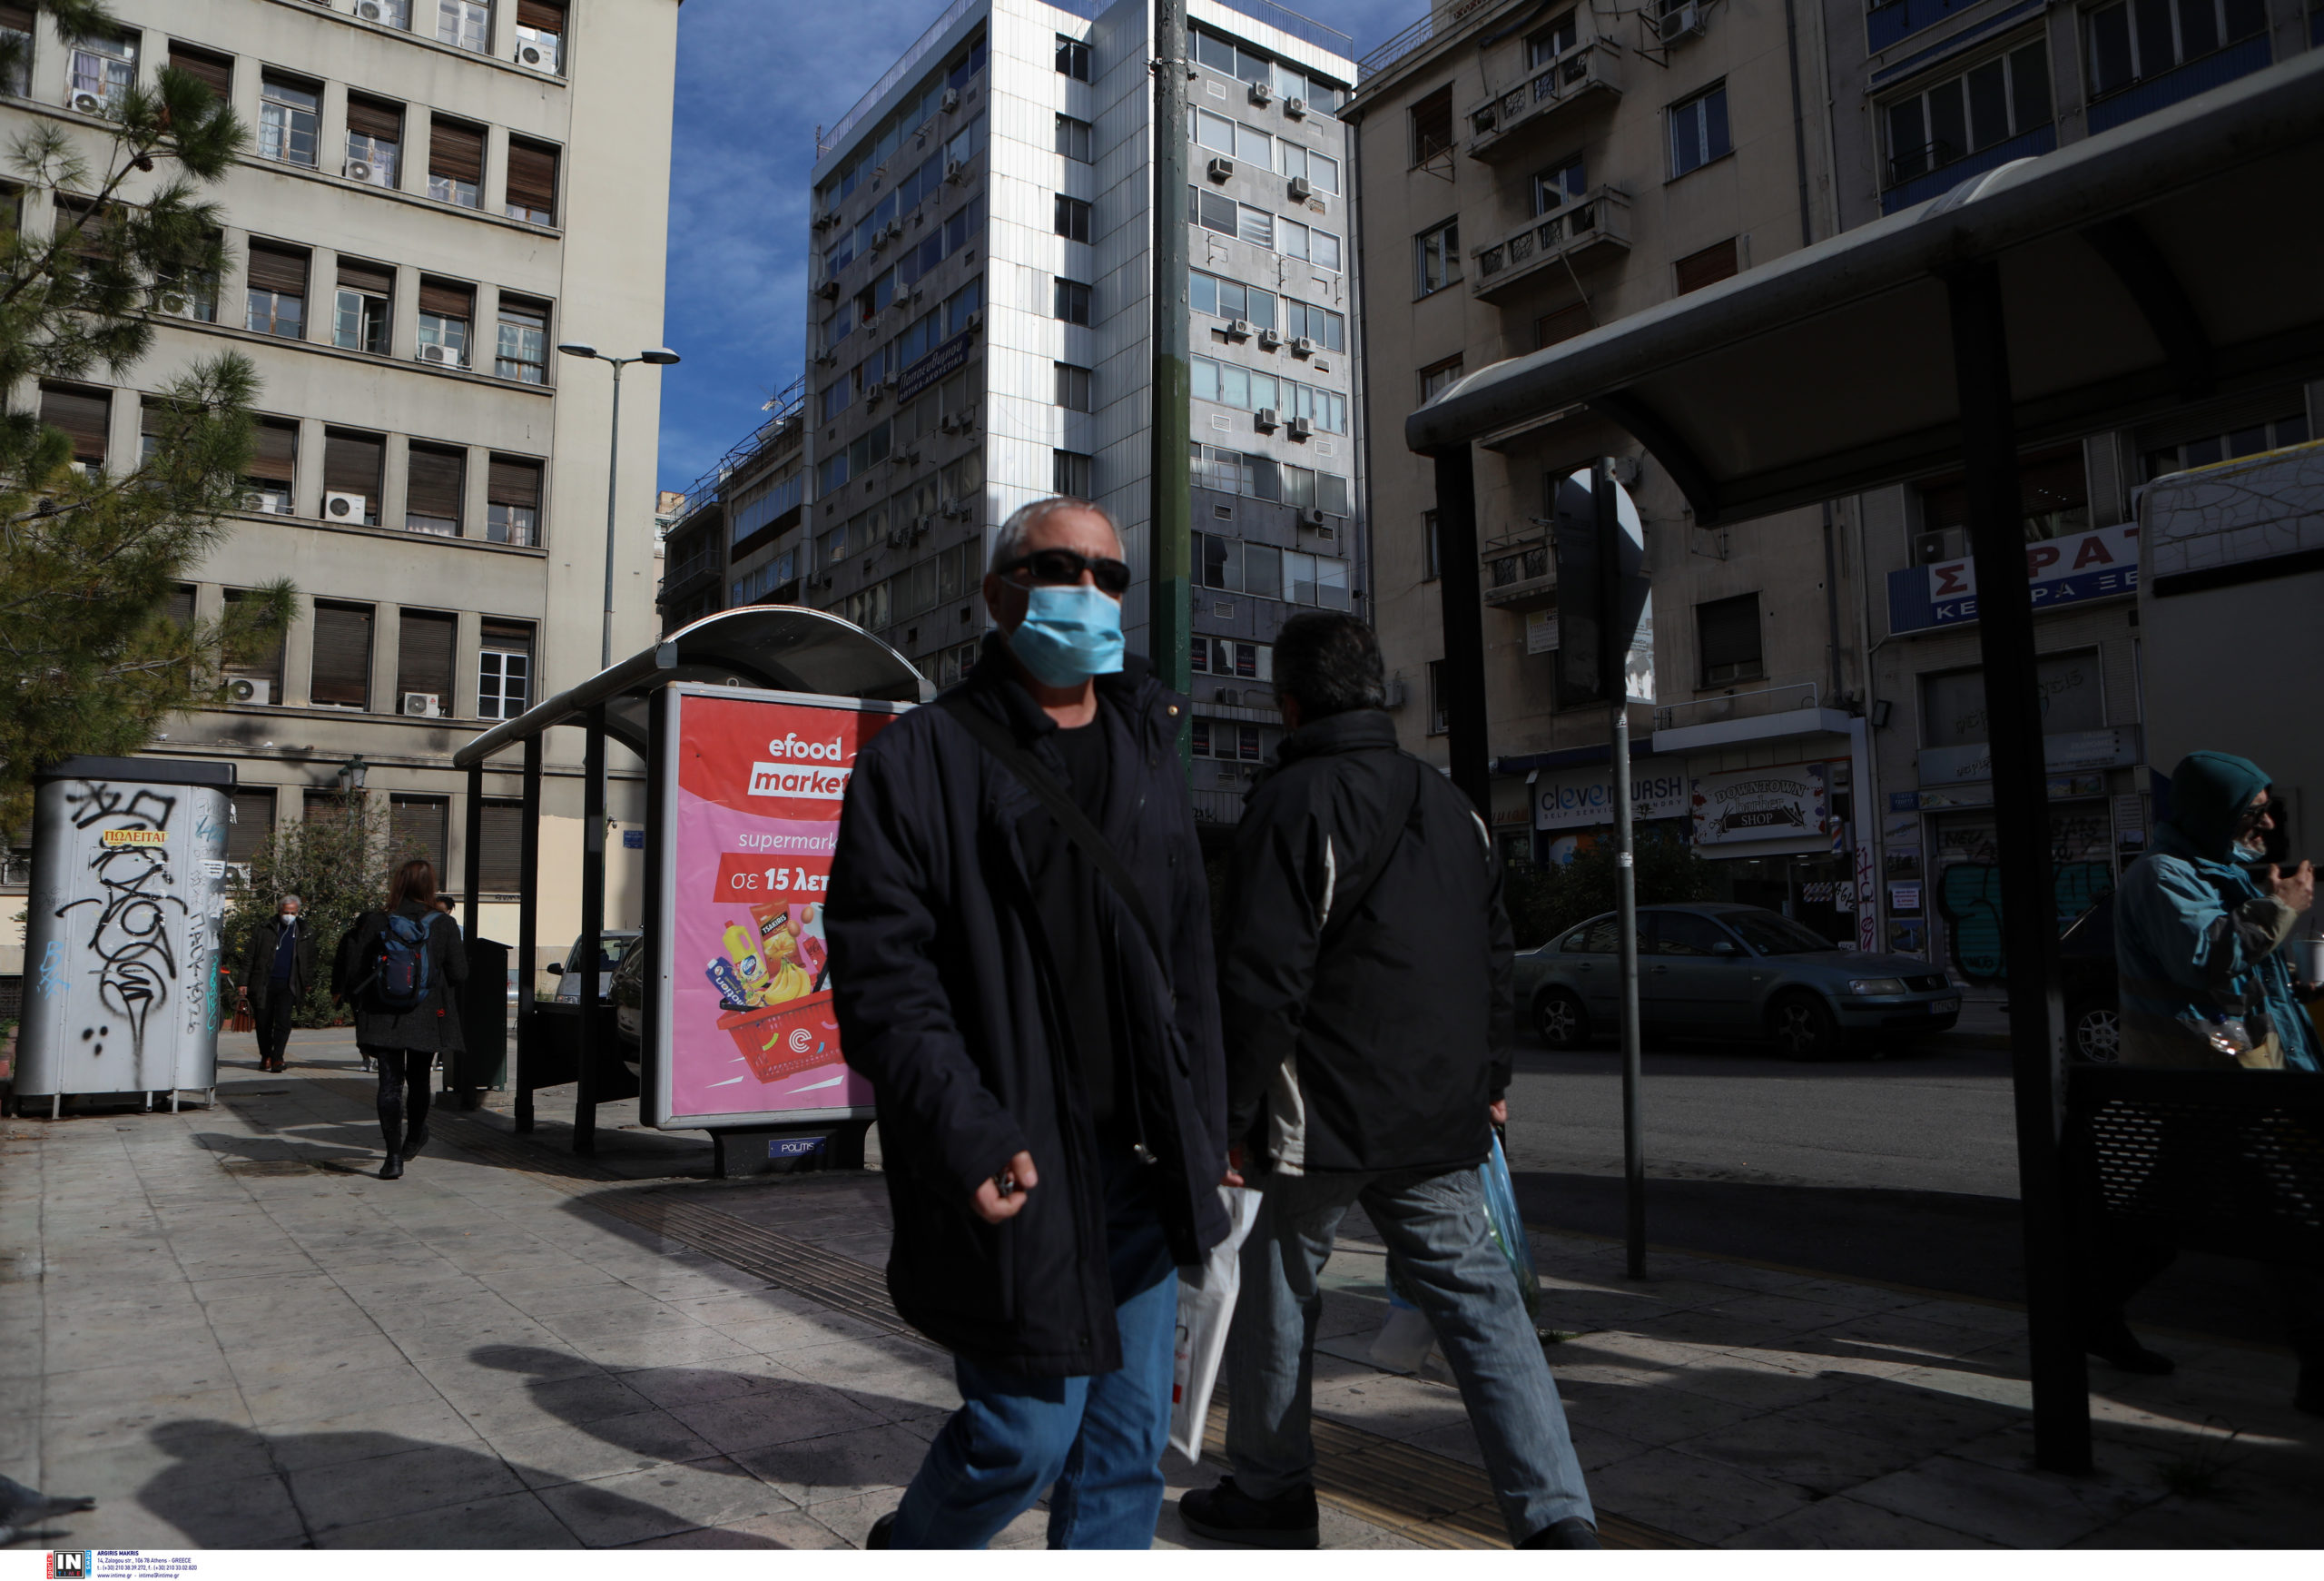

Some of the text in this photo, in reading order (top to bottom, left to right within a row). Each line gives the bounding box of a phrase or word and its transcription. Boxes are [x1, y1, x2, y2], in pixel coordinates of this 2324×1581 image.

[769, 732, 842, 761] efood
[1715, 780, 1806, 804] DOWNTOWN
[1576, 805, 1615, 816] SERVIC
[1735, 795, 1784, 813] barber
[1741, 814, 1773, 826] SHOP
[104, 831, 165, 843] ΠΩΛΕΙΤΑΙ
[731, 874, 759, 890] σε
[764, 868, 789, 891] 15
[763, 914, 787, 934] TSAKIRIS
